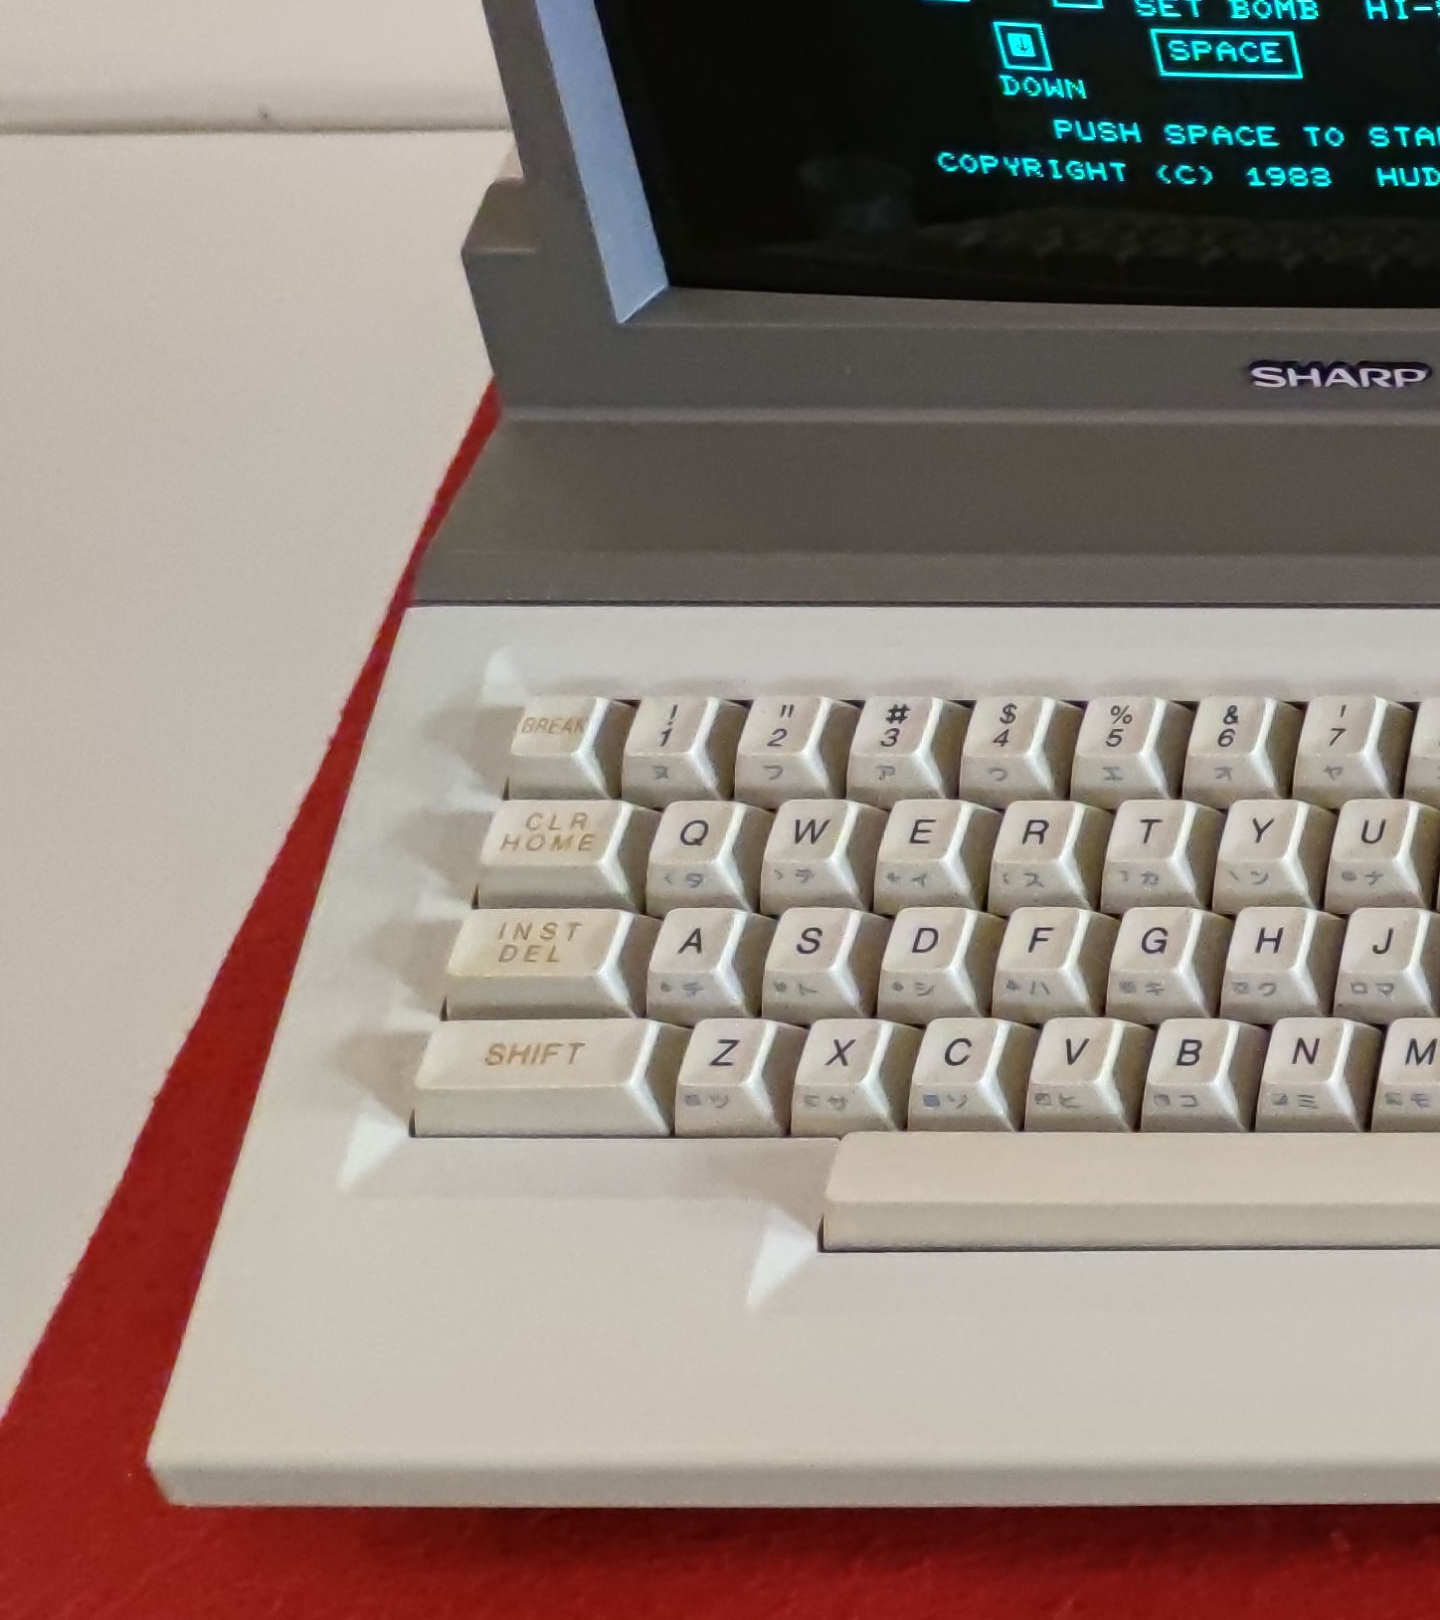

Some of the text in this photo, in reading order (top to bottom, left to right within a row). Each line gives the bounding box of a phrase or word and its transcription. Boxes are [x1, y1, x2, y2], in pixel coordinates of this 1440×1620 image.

[1168, 41, 1284, 64] SPACE
[999, 74, 1088, 99] DOWN
[1053, 120, 1142, 143] PUSH
[1164, 124, 1279, 147] SPACE
[1302, 125, 1346, 147] TO
[936, 151, 1127, 182] COPYRIGHT
[1156, 165, 1214, 185] (C)
[1246, 167, 1331, 187] 1983
[1251, 366, 1428, 389] SHARP
[521, 716, 587, 736] BREAK
[526, 812, 591, 831] CLR
[680, 818, 709, 845] Q
[793, 818, 831, 845] W
[908, 818, 937, 845] E
[1022, 818, 1050, 845] R
[1139, 818, 1163, 845] T
[1251, 818, 1275, 845] Y
[1360, 818, 1386, 845] U
[500, 833, 595, 852] HOME
[498, 921, 583, 943] INST
[677, 927, 703, 955] A
[796, 927, 823, 955] S
[911, 927, 939, 955] D
[1027, 927, 1054, 955] F
[498, 944, 562, 963] DEL
[485, 1041, 586, 1066] SHIFT
